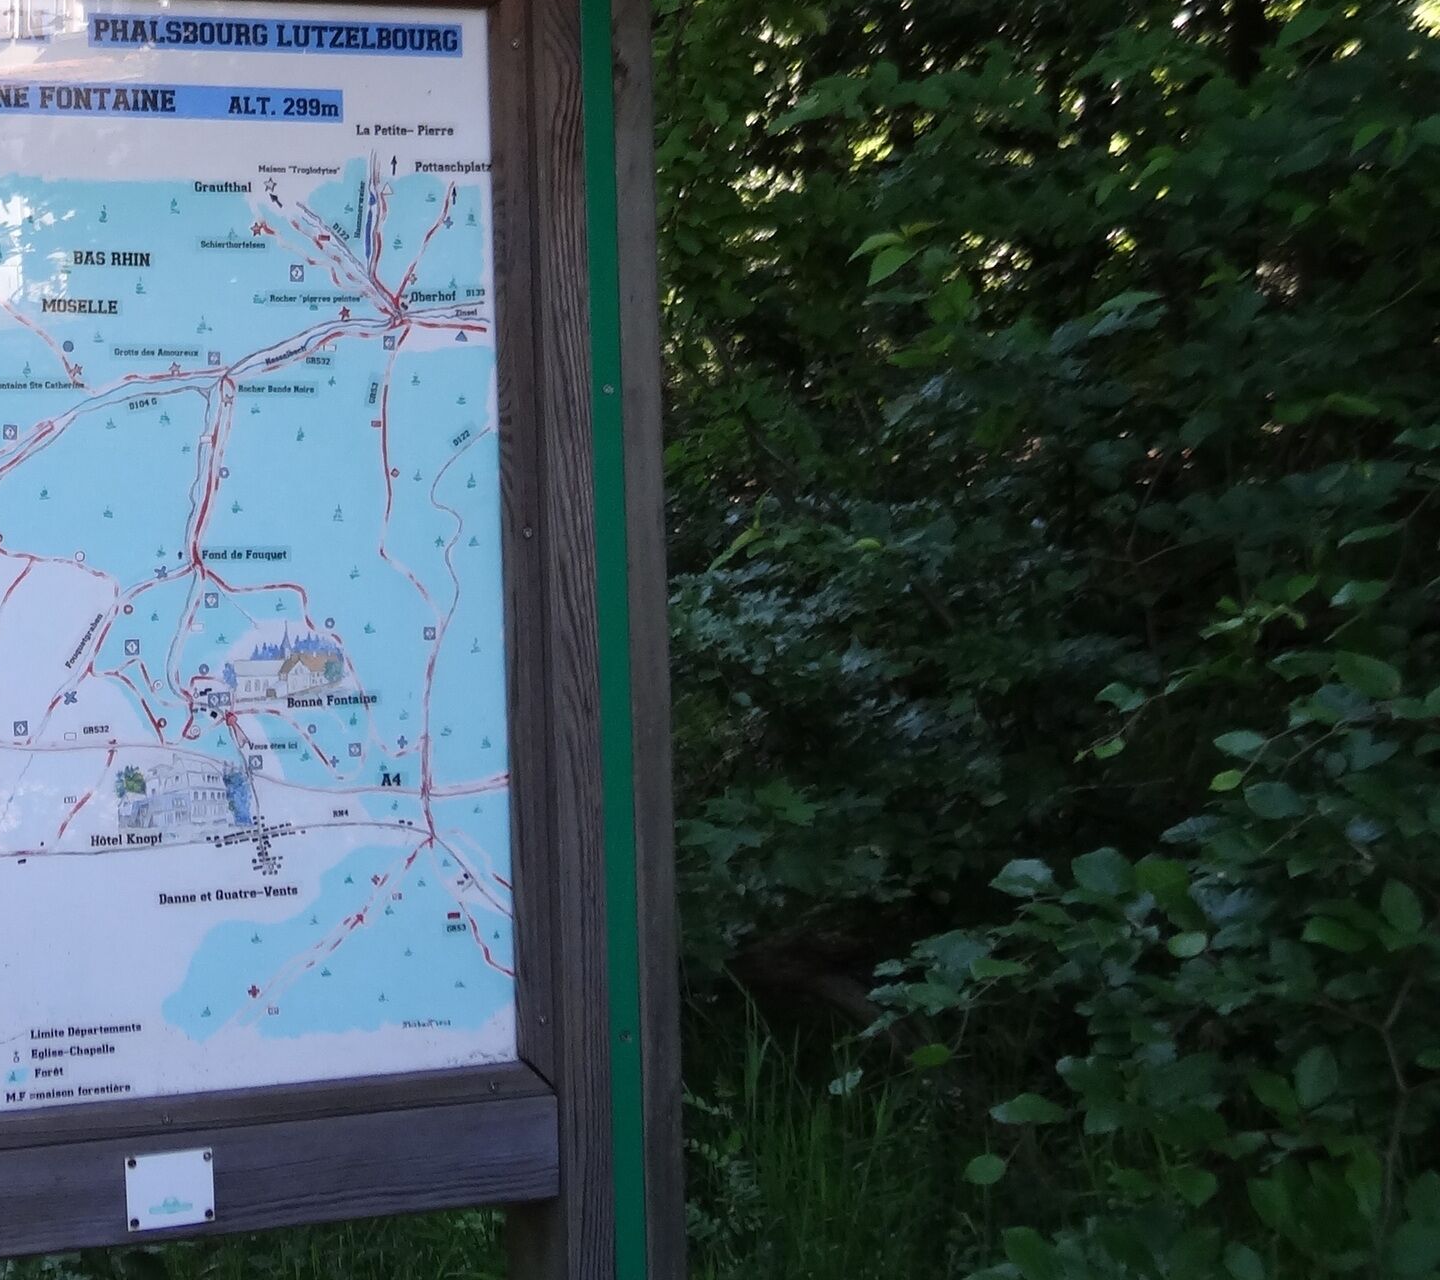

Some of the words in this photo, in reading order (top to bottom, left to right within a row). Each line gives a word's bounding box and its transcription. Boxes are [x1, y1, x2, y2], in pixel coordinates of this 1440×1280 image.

[93, 19, 268, 47] PHALSBOURG
[276, 24, 458, 52] LUTZELBOURG
[39, 86, 176, 112] FONTAINE
[227, 95, 276, 116] ALT.
[283, 97, 339, 117] 299m
[356, 125, 370, 136] La
[417, 125, 454, 136] Pierre
[415, 161, 492, 174] Pottaschplatz
[194, 181, 252, 193] Graufthal
[73, 251, 105, 265] BAS
[111, 252, 150, 267] RHIN
[270, 294, 297, 303] Rocher
[410, 290, 456, 302] Oberhof
[42, 299, 118, 314] MOSELLE
[141, 348, 155, 356] des
[129, 400, 149, 410] D104
[452, 430, 470, 447] D122
[201, 549, 228, 560] Fond
[230, 549, 243, 560] de
[245, 549, 287, 561] Fouquet
[287, 697, 323, 708] Bonne
[381, 773, 401, 787] A4
[90, 834, 122, 847] Hôtel
[126, 832, 162, 847] Knopf
[159, 893, 197, 905] Danne
[200, 891, 212, 902] et
[215, 886, 298, 901] Quatre-Vents
[30, 1027, 65, 1040] Limite
[67, 1023, 142, 1038] Départements
[34, 1066, 64, 1079] Forêt
[78, 1083, 131, 1096] forestière
